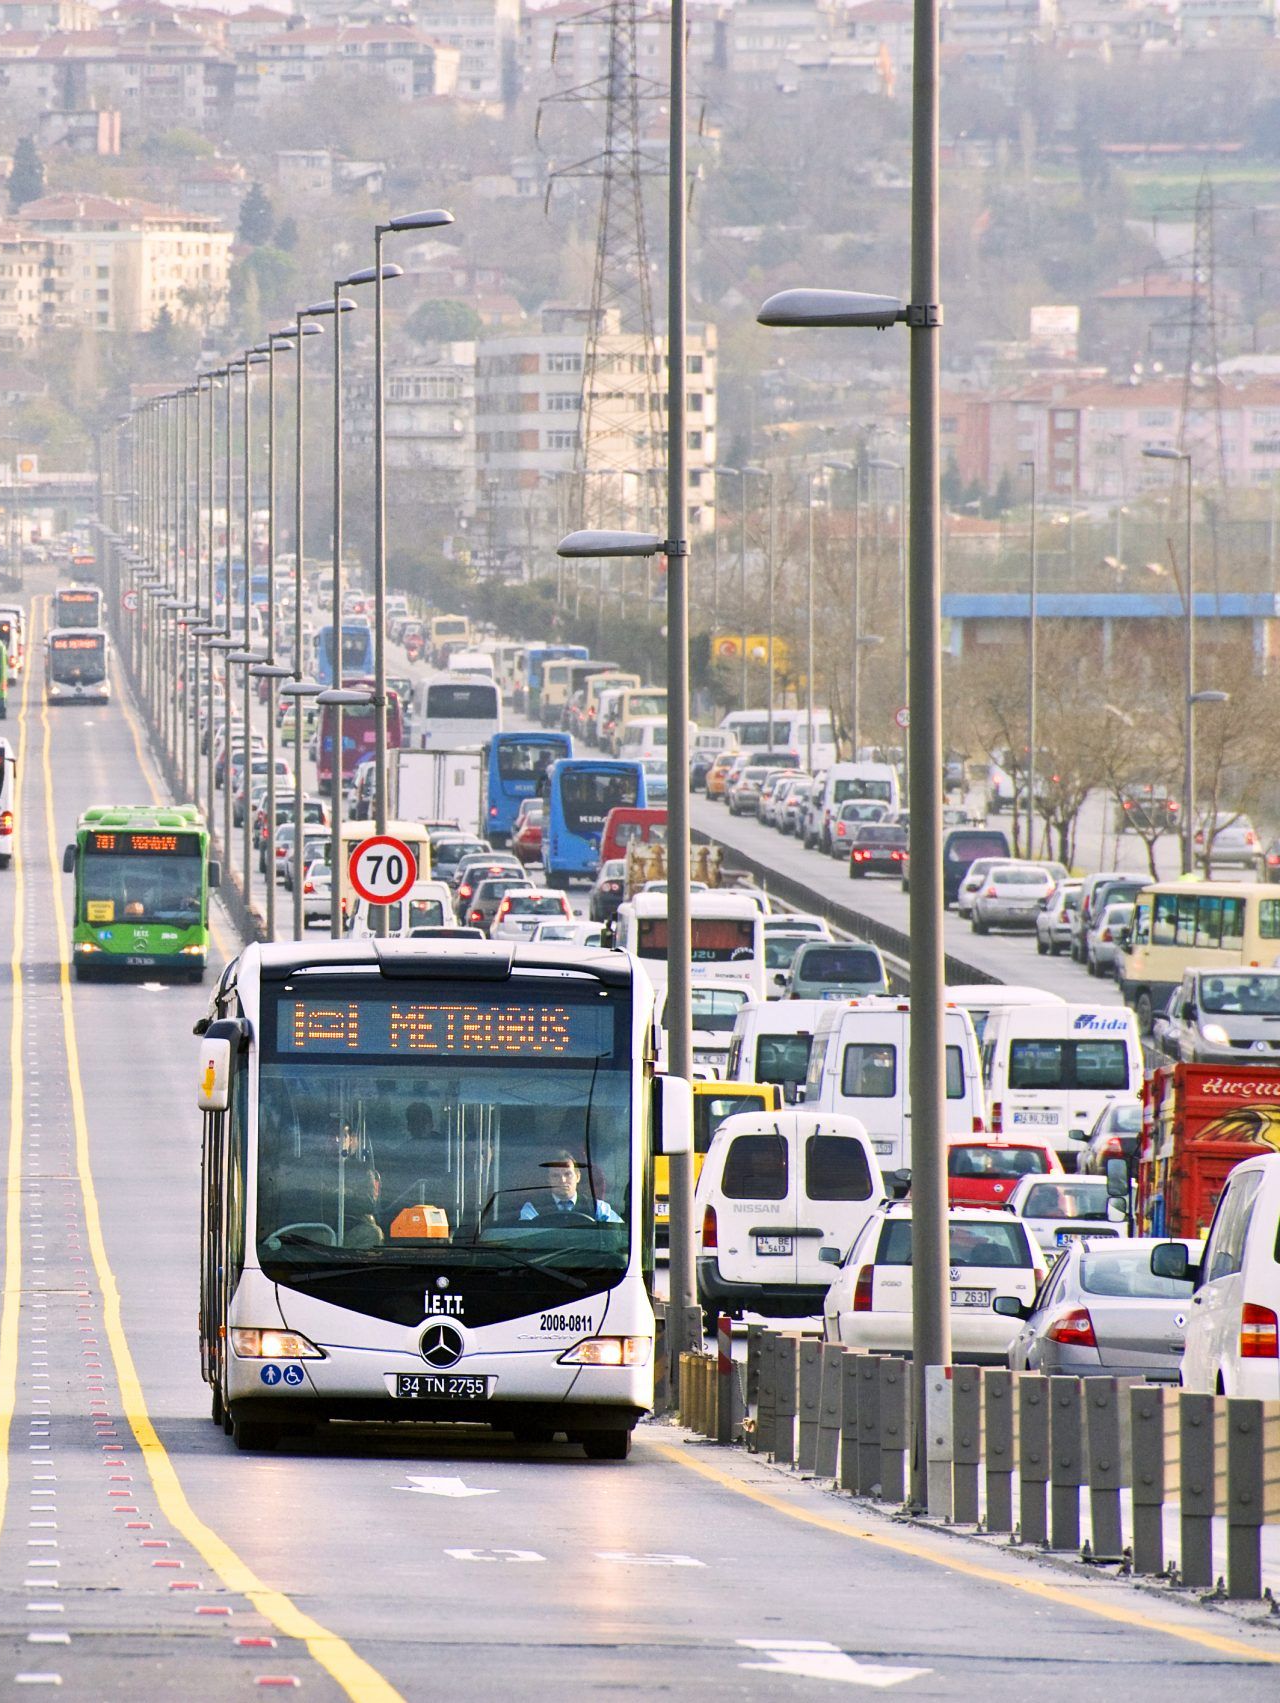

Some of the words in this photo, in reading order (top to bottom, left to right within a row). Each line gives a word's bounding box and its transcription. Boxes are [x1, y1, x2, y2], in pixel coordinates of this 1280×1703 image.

[366, 854, 403, 885] 70
[733, 1204, 780, 1213] NISSAN
[964, 1289, 989, 1302] 2631
[540, 1314, 592, 1332] 2008-0811
[402, 1378, 420, 1392] 34
[425, 1378, 445, 1393] TN
[449, 1379, 484, 1394] 2755
